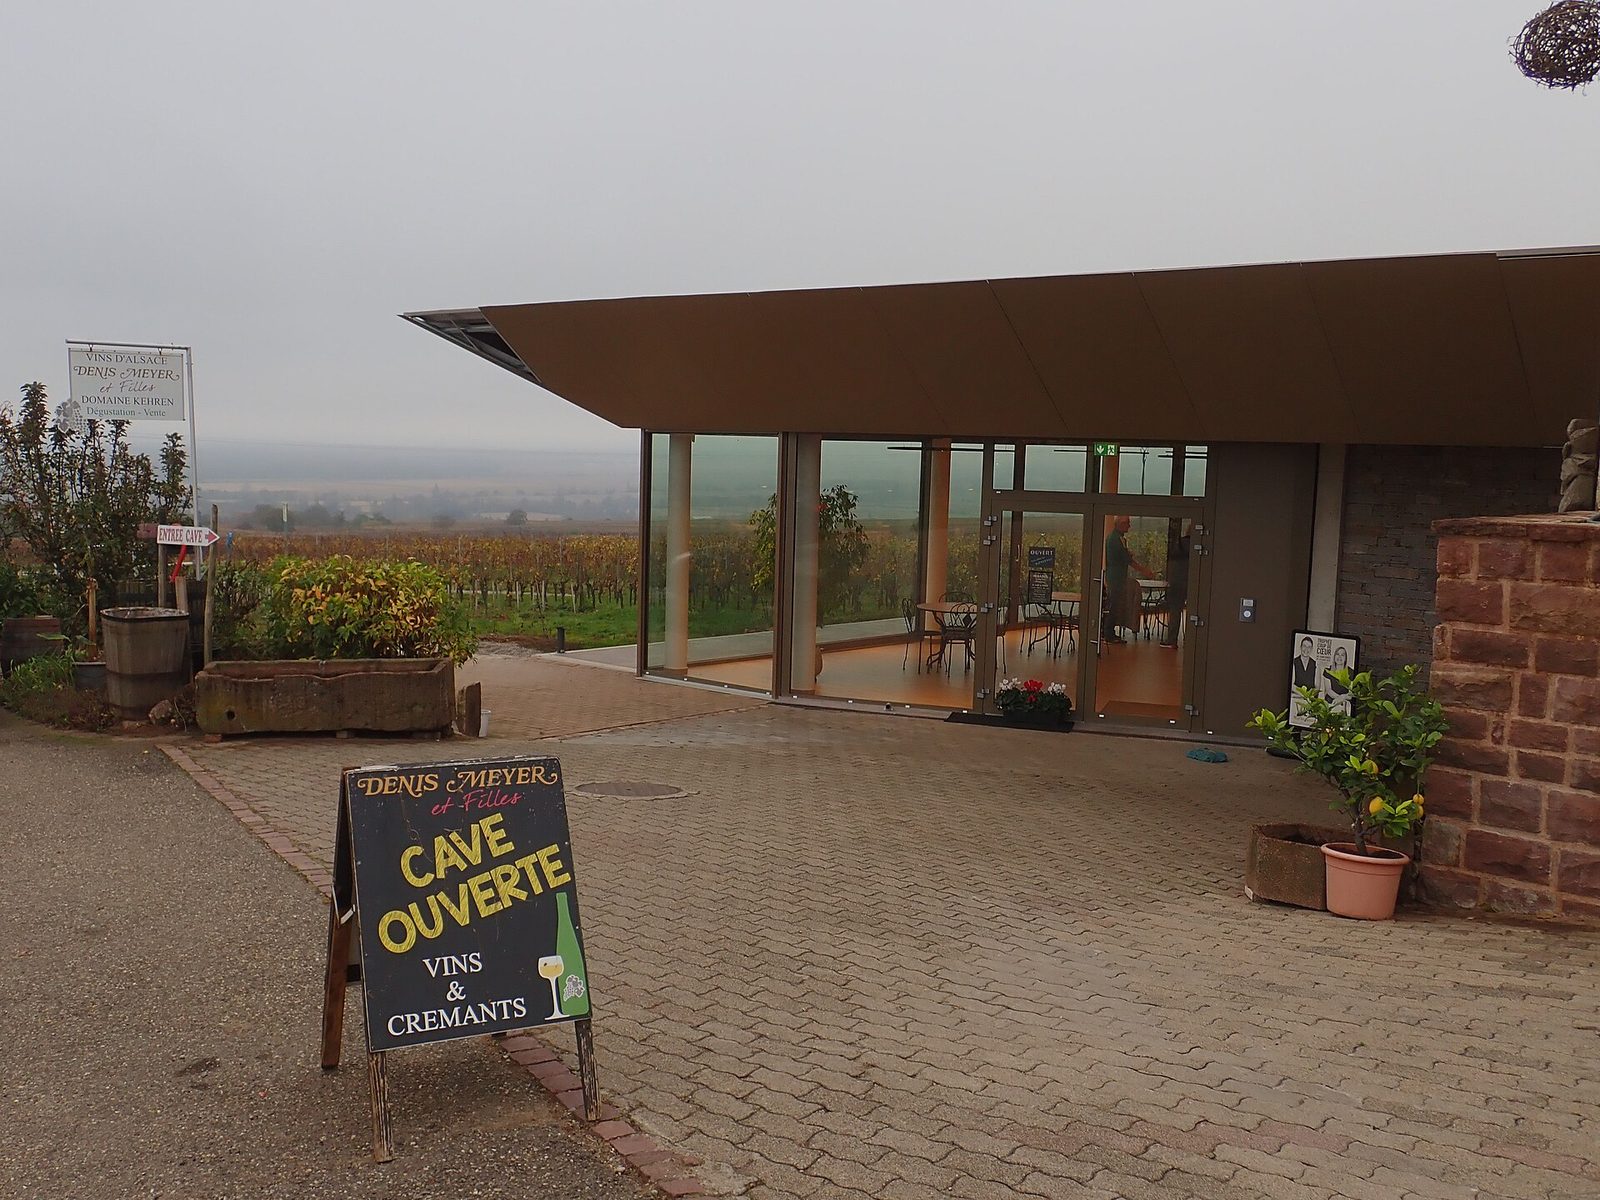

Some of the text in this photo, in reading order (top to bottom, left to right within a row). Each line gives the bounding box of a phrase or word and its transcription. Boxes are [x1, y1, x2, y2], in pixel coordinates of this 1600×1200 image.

[86, 353, 167, 365] VINS D'ALSACE
[74, 366, 180, 381] DENIS MEYER
[100, 380, 156, 393] et Filles
[81, 395, 175, 406] DOMAINE KEHREN
[143, 408, 166, 417] Vente
[185, 529, 203, 543] CAVE
[357, 766, 558, 798] DENIS MEYER
[431, 789, 523, 816] et Filles
[400, 812, 515, 888] CAVE
[378, 843, 572, 954] OUVERTE
[422, 952, 483, 978] VINS
[446, 980, 466, 1002] &
[387, 997, 527, 1037] CREMANTS
